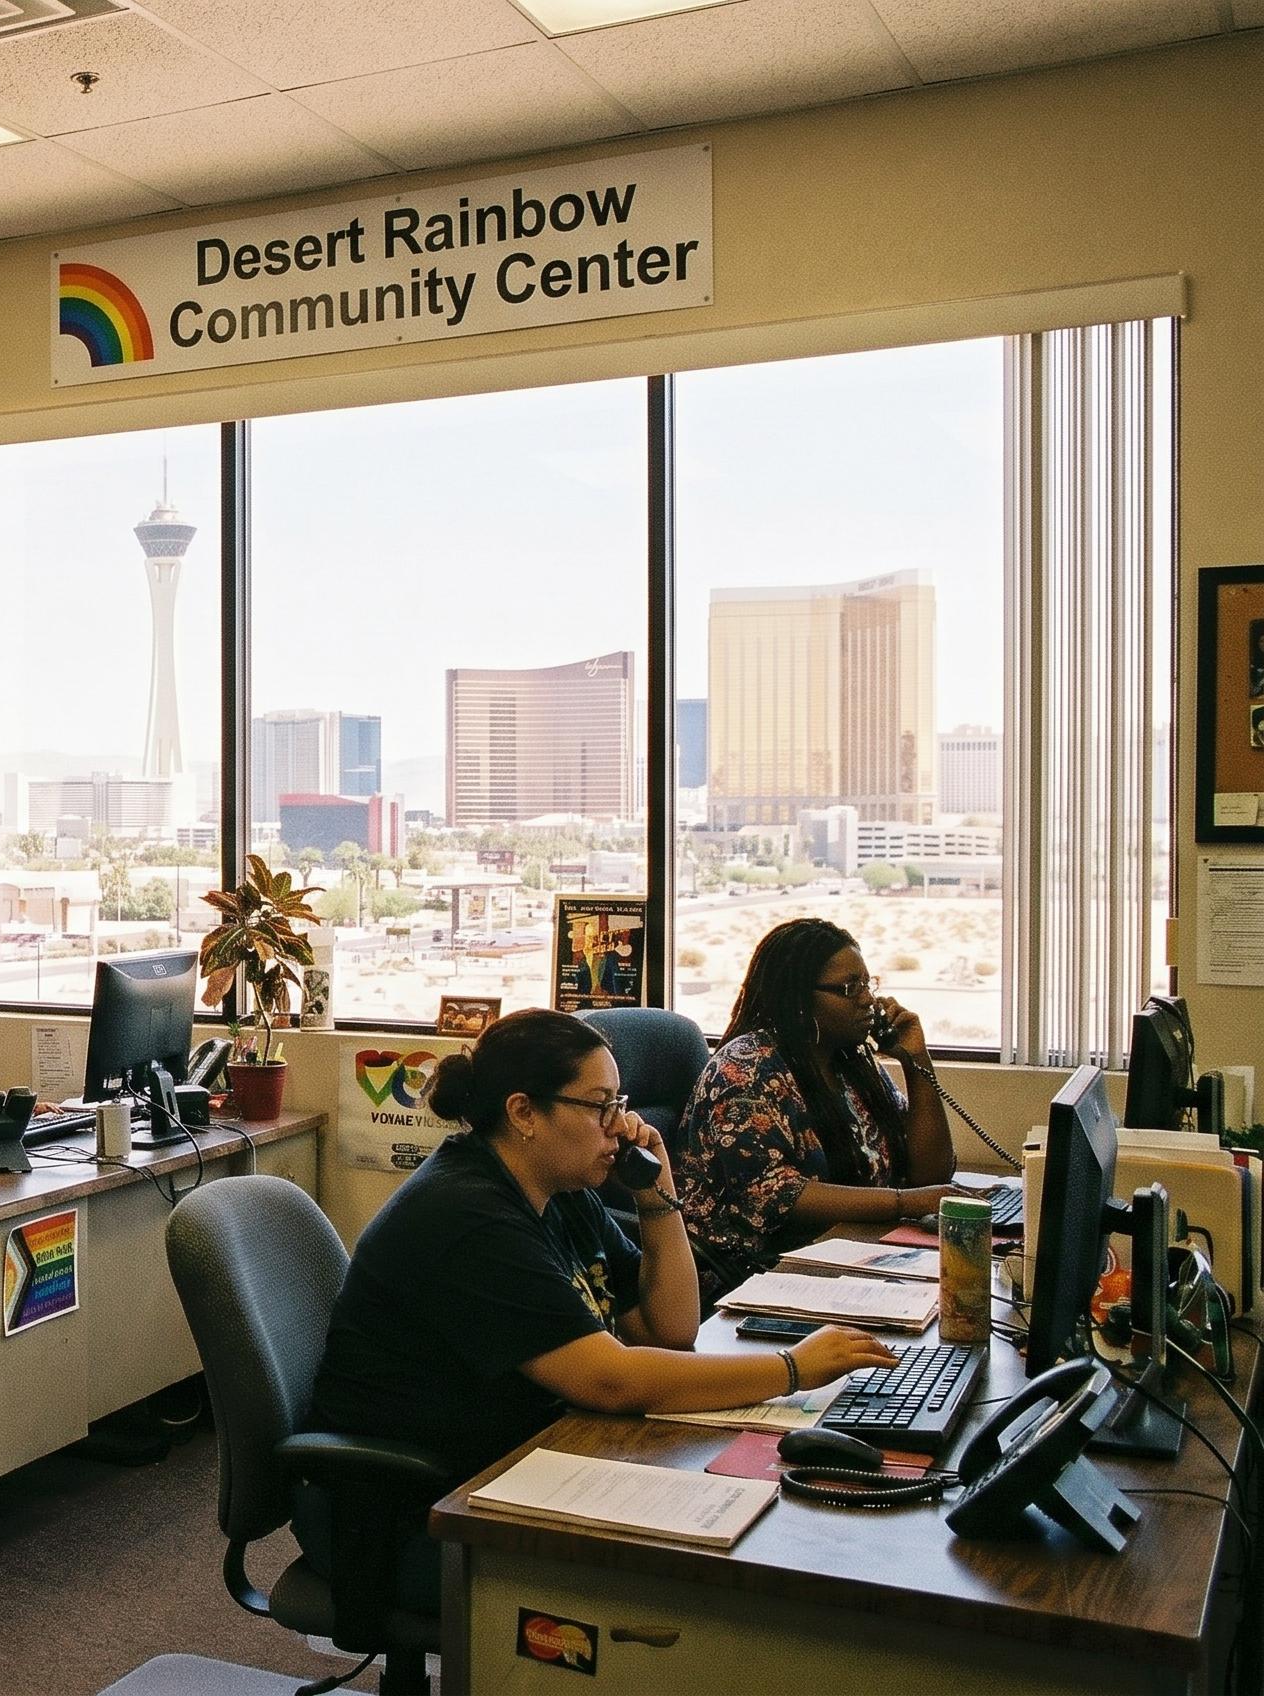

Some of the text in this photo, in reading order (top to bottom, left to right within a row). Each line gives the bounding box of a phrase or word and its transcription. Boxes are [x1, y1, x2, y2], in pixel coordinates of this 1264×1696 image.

[196, 183, 637, 286] Desert Rainbow
[169, 239, 699, 348] Community Center
